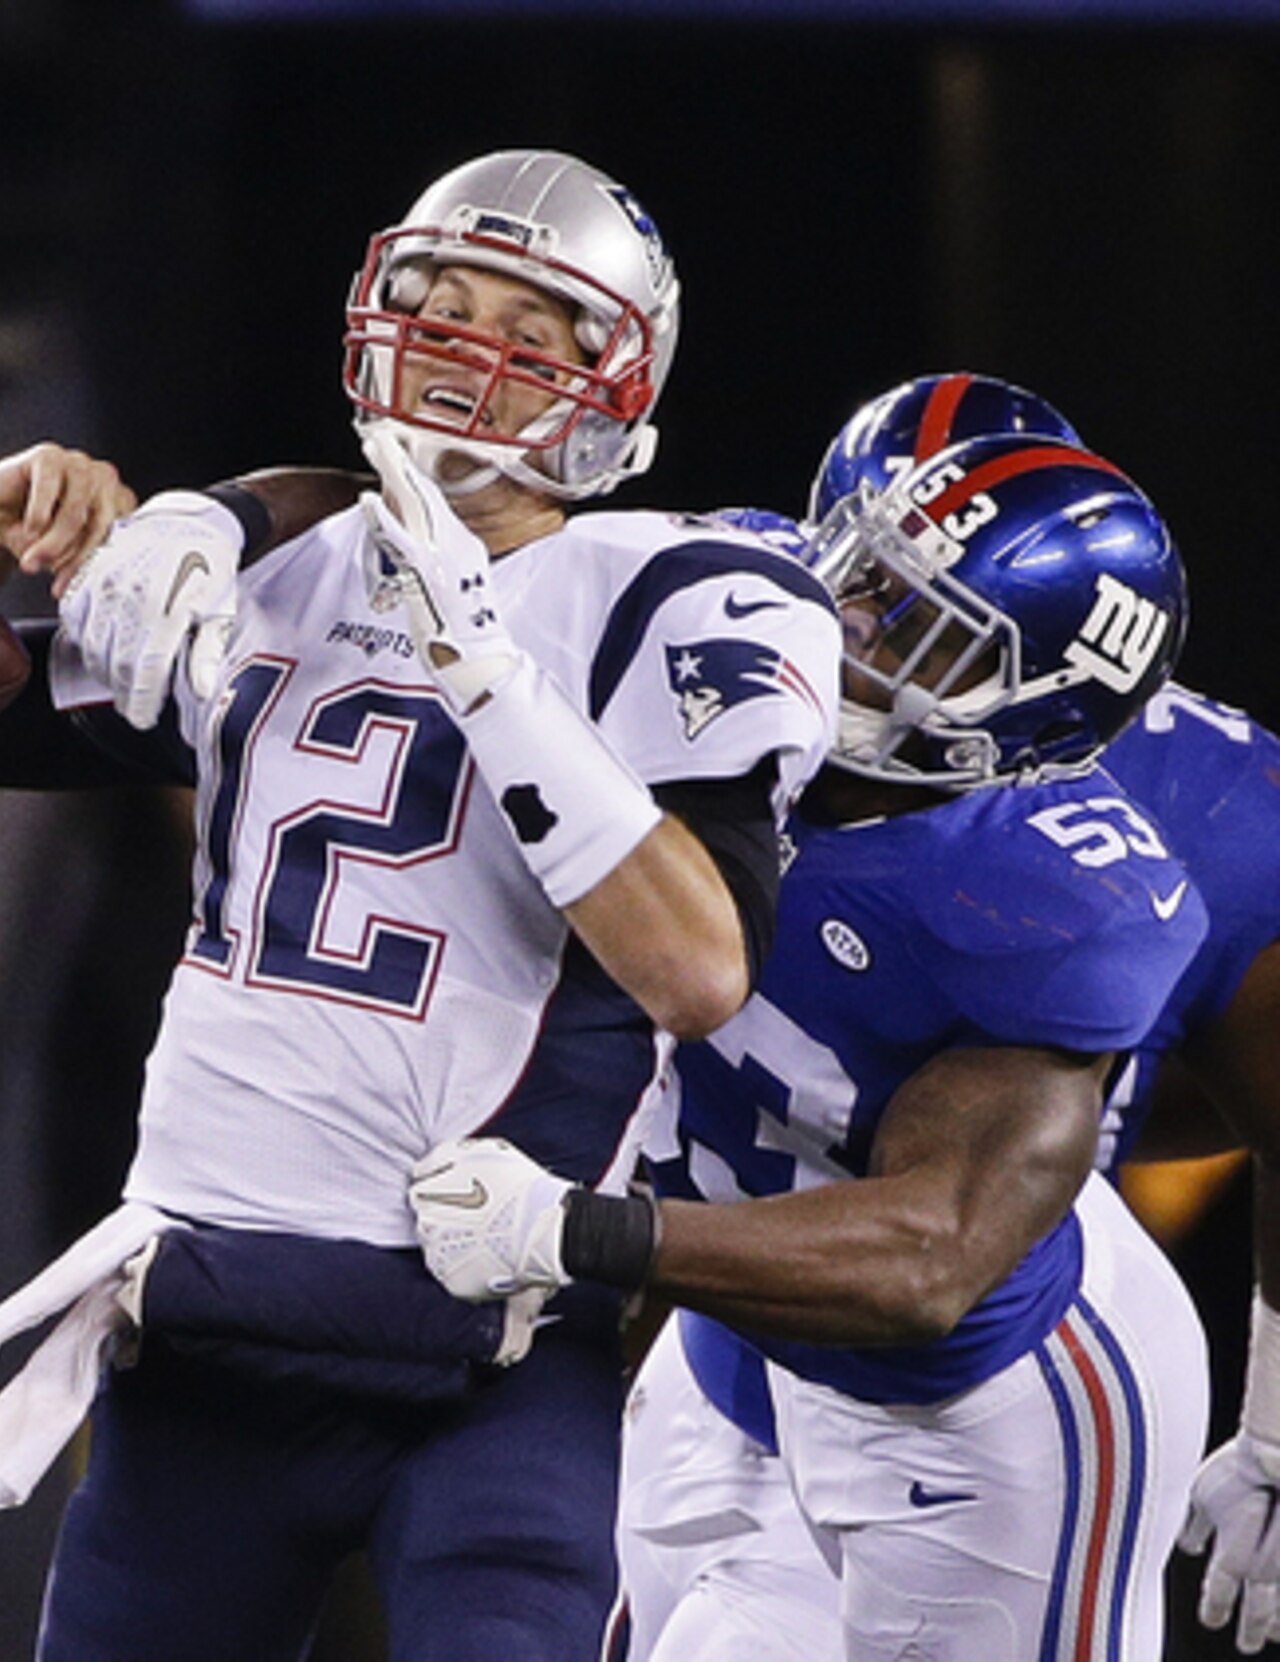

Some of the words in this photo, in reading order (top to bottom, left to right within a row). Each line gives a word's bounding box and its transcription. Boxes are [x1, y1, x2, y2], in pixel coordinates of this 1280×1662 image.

[912, 462, 1000, 541] 53
[179, 652, 477, 1023] 12
[1026, 797, 1169, 868] 53
